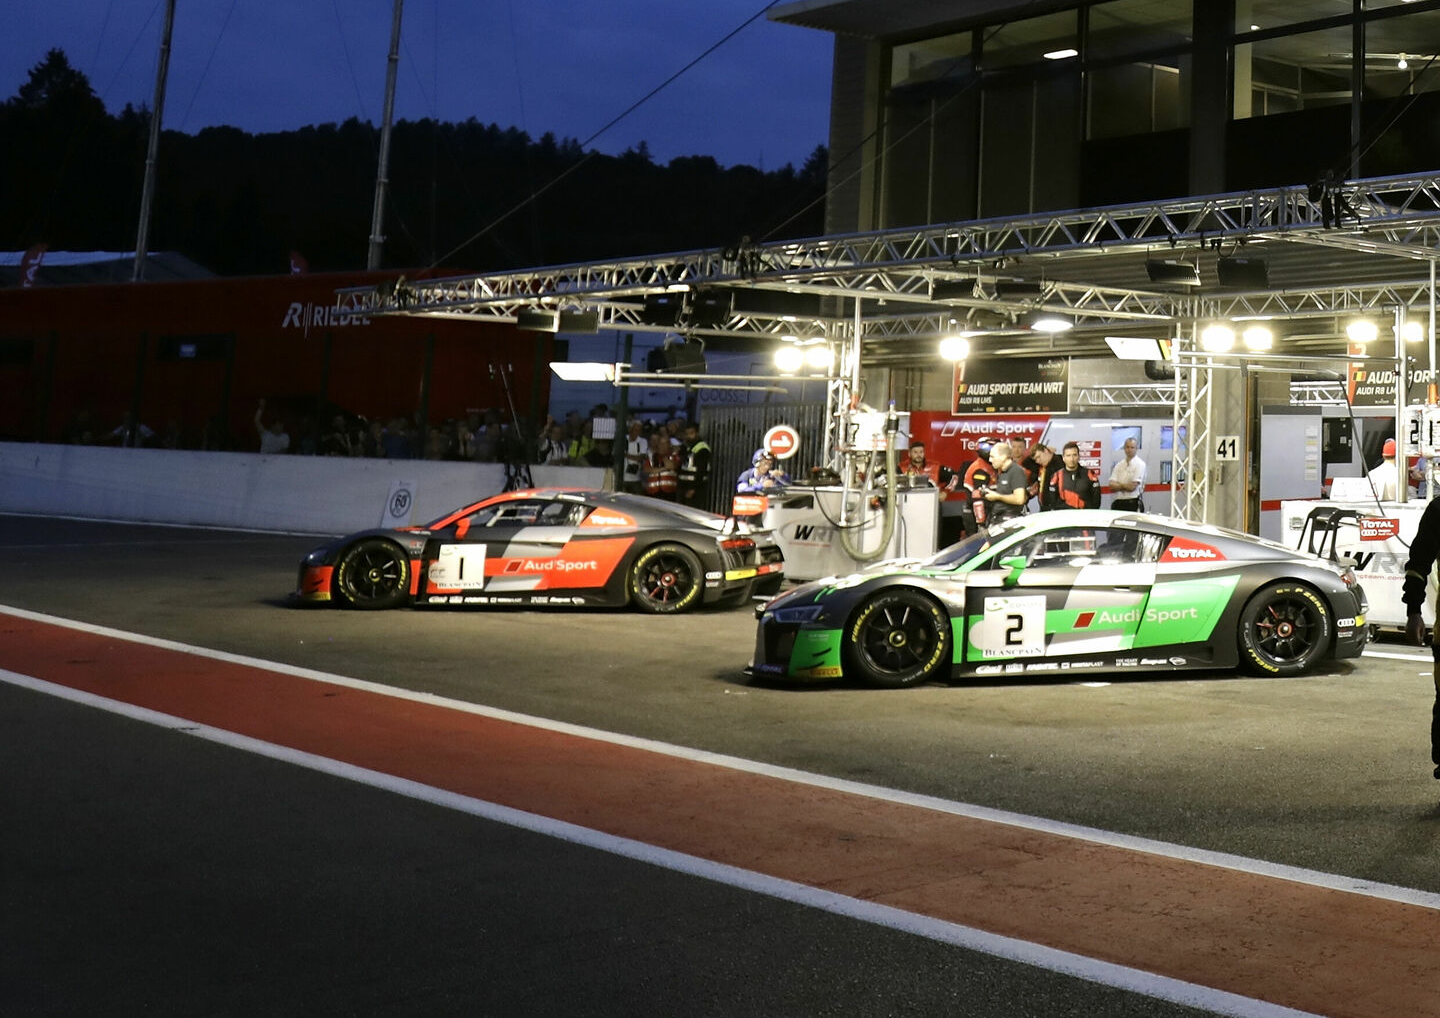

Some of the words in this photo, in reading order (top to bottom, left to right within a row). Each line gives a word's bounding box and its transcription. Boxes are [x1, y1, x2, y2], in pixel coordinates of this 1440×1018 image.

[313, 304, 371, 326] RIEDEL
[967, 384, 989, 396] AUDI
[989, 383, 1018, 395] SPORT
[1019, 382, 1041, 394] TEAM
[1043, 382, 1064, 394] WRT
[1356, 387, 1374, 395] AUDI
[960, 422, 993, 434] Audi
[996, 422, 1035, 435] Sport
[1411, 420, 1419, 445] 2
[1217, 439, 1236, 458] 41
[590, 515, 629, 526] TOTAL
[1361, 519, 1395, 529] TOTAL
[1168, 547, 1217, 559] TOTAL
[459, 557, 464, 580] 1
[556, 559, 597, 572] Sport
[1098, 609, 1140, 625] Audi
[1146, 607, 1198, 625] Sport
[1005, 614, 1024, 646] 2
[984, 647, 1043, 657] BLANCPAIN
